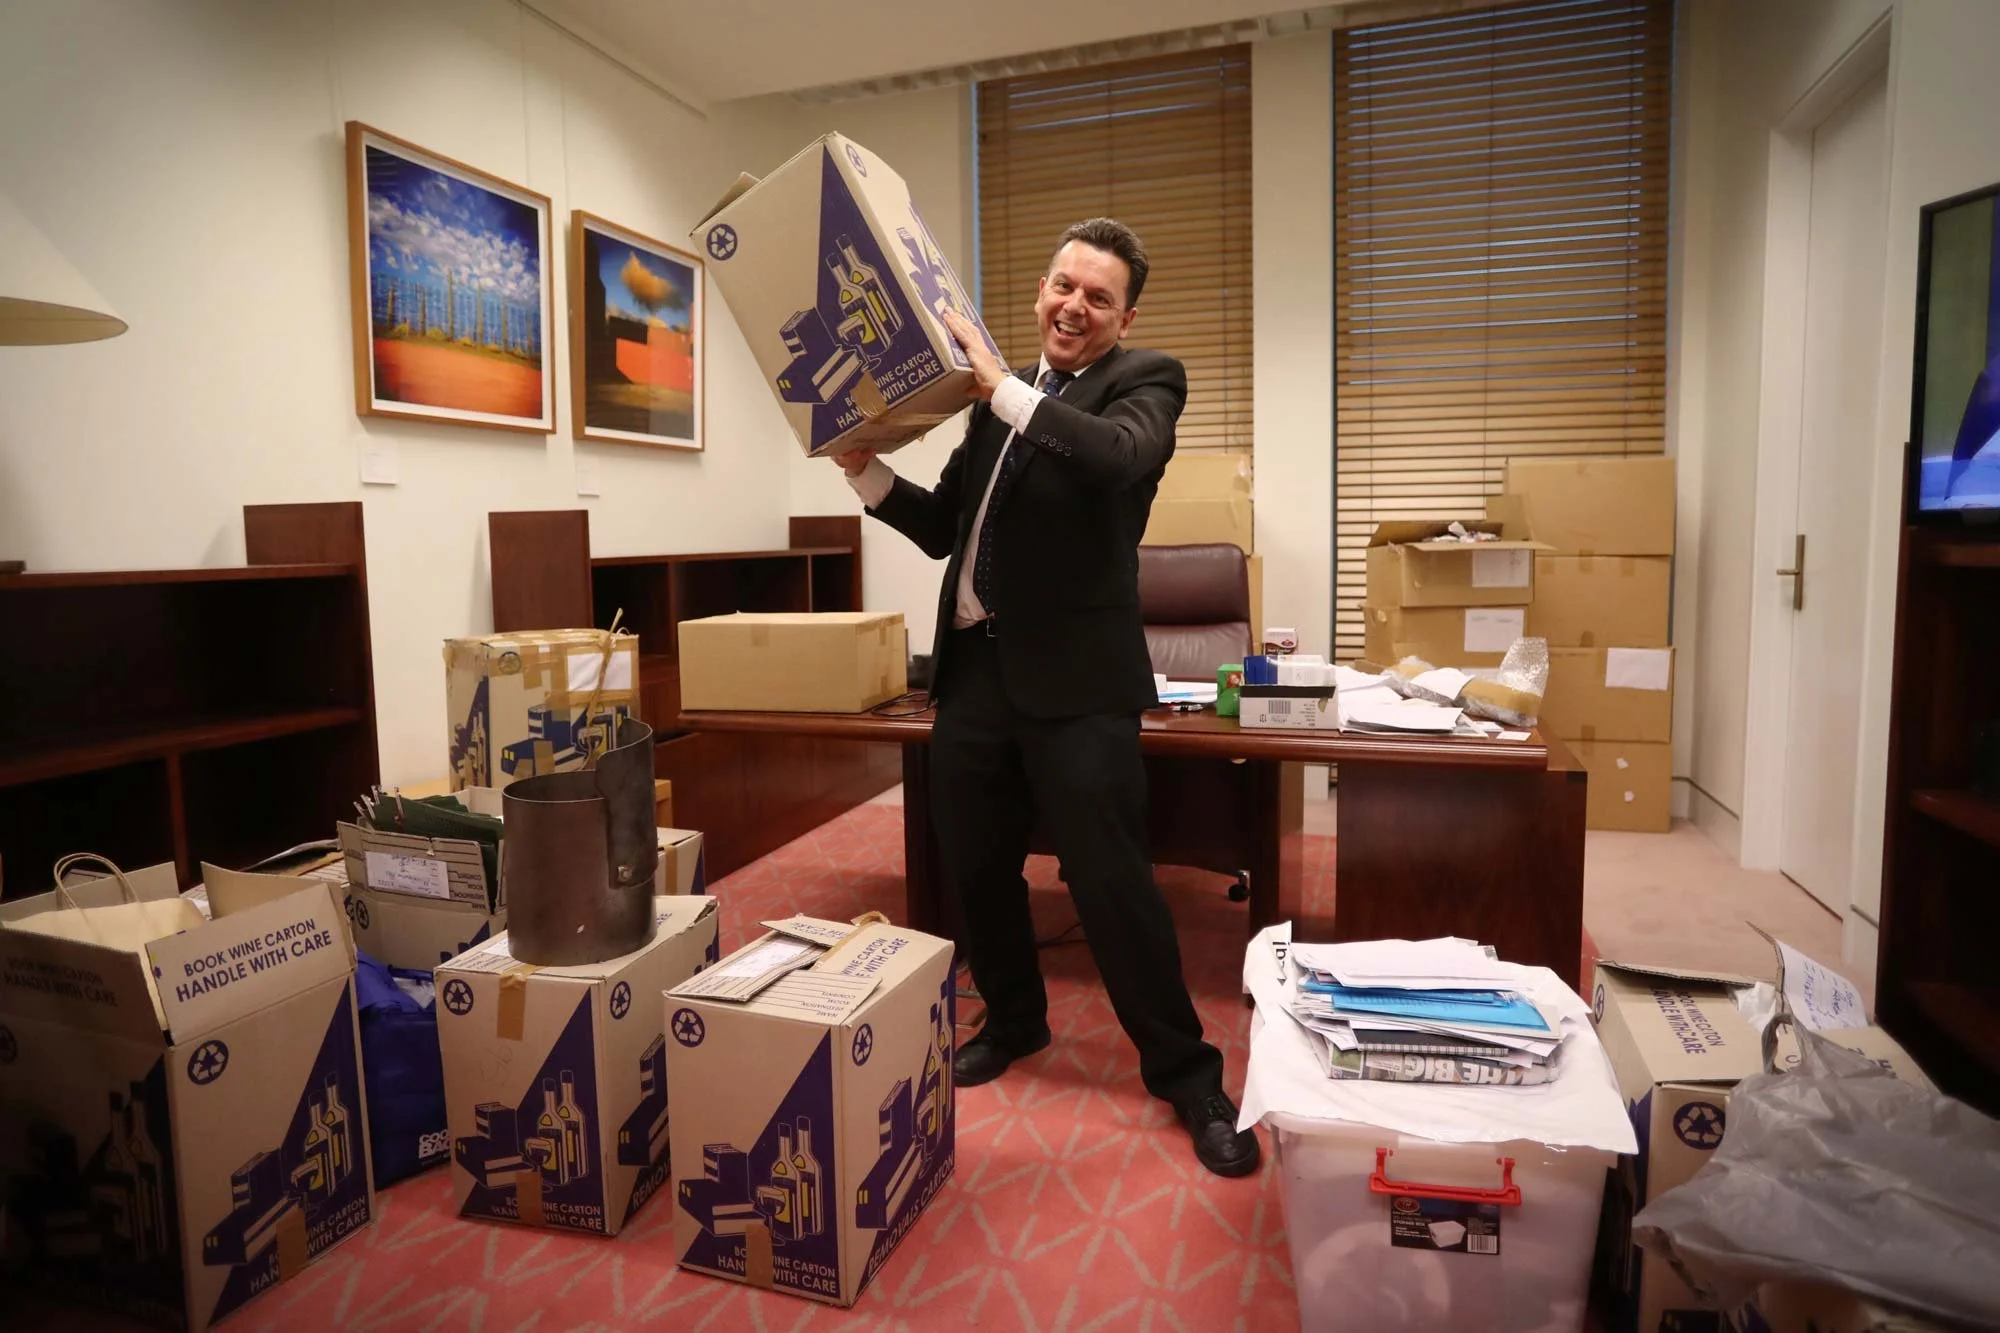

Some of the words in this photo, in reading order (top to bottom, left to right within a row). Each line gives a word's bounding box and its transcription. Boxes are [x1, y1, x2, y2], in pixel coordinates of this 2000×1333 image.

[894, 348, 932, 376] CARTON
[836, 407, 863, 429] HAN
[881, 380, 908, 402] WITH
[908, 361, 940, 385] CARE
[184, 952, 228, 977] BOOK
[228, 938, 263, 960] WINE
[264, 918, 316, 947] CARTON
[857, 938, 888, 960] CARTON
[864, 955, 889, 973] WITH
[882, 938, 910, 955] CARE
[176, 962, 248, 1002] HANDLE
[248, 946, 289, 973] WITH
[291, 930, 332, 958] CARE
[1404, 1054, 1456, 1083] BIG
[419, 1129, 449, 1144] COO
[920, 1150, 954, 1205] CARTON
[327, 1195, 366, 1226] CARTON
[491, 1205, 519, 1217] HAN
[570, 1216, 602, 1230] CARE
[560, 1203, 600, 1215] CARTON
[250, 1265, 279, 1293] HAN
[336, 1207, 367, 1235] CARE
[718, 1255, 745, 1272] HAN
[802, 1275, 837, 1293] CARE
[792, 1259, 836, 1278] CARTON
